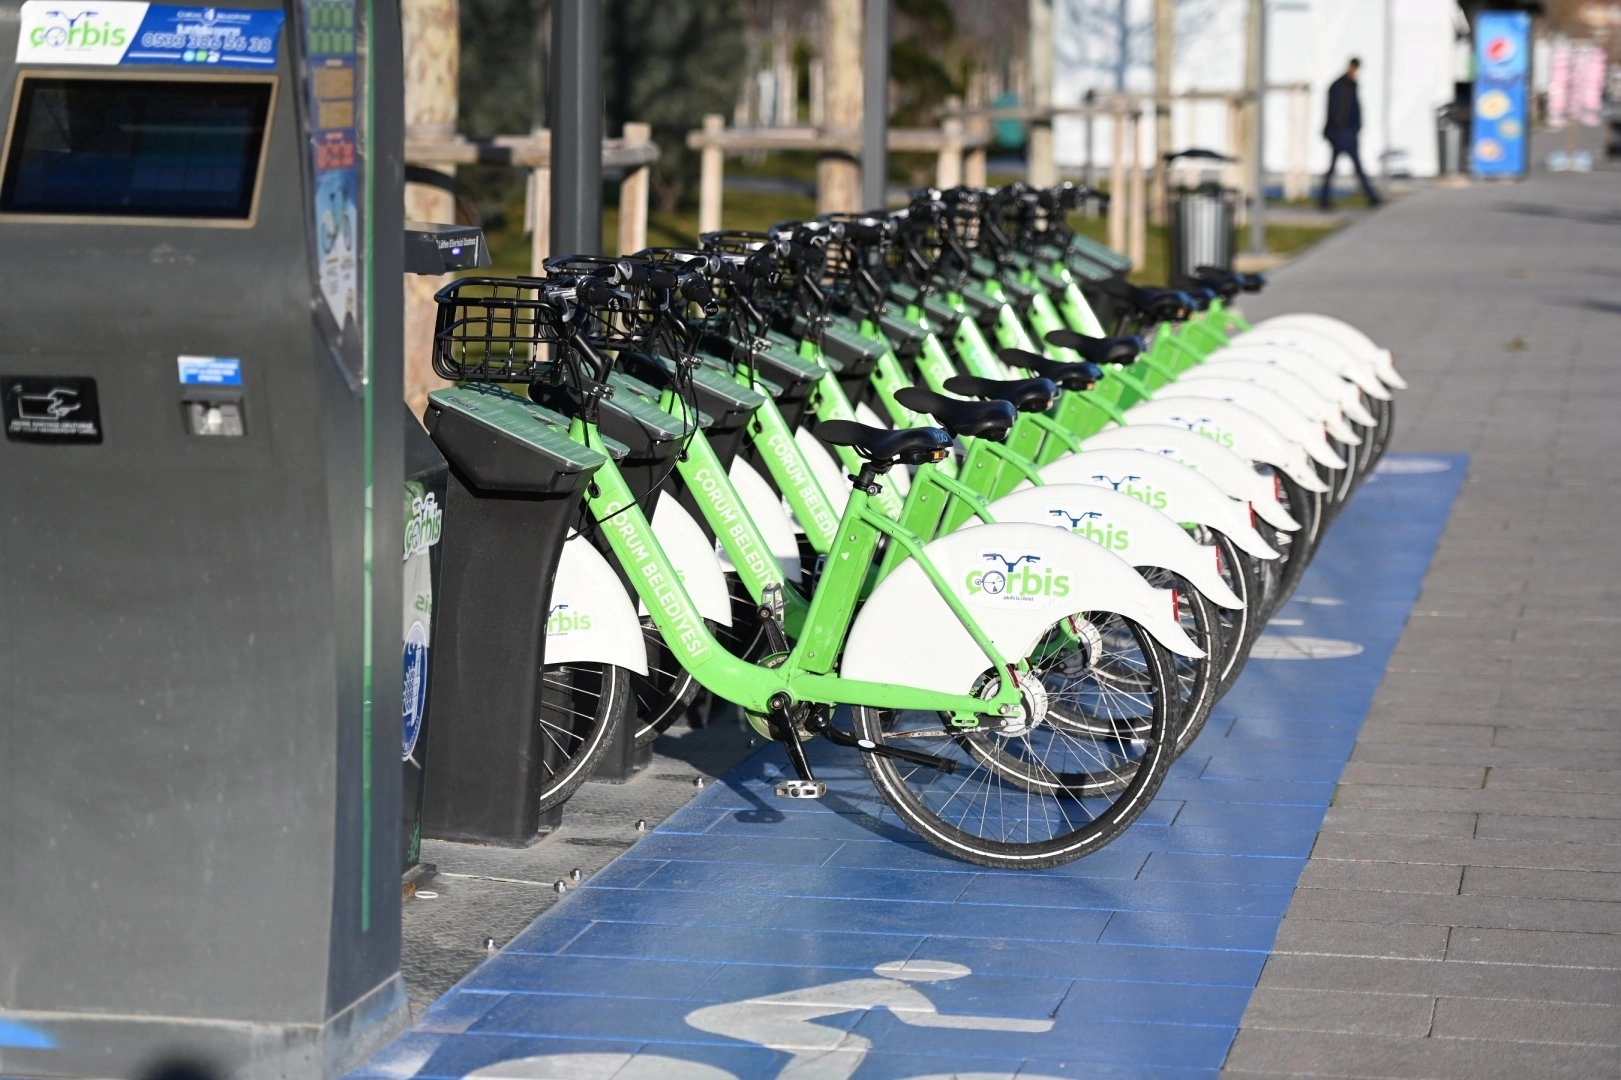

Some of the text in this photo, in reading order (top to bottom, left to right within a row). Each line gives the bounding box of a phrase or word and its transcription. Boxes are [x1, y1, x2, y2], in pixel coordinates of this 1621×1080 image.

[768, 434, 804, 487] ÇORUM
[694, 468, 777, 586] ÇORUM BELEDİY
[604, 501, 709, 658] ÇORUM BELEDİYESİ
[965, 565, 1070, 598] çorbis
